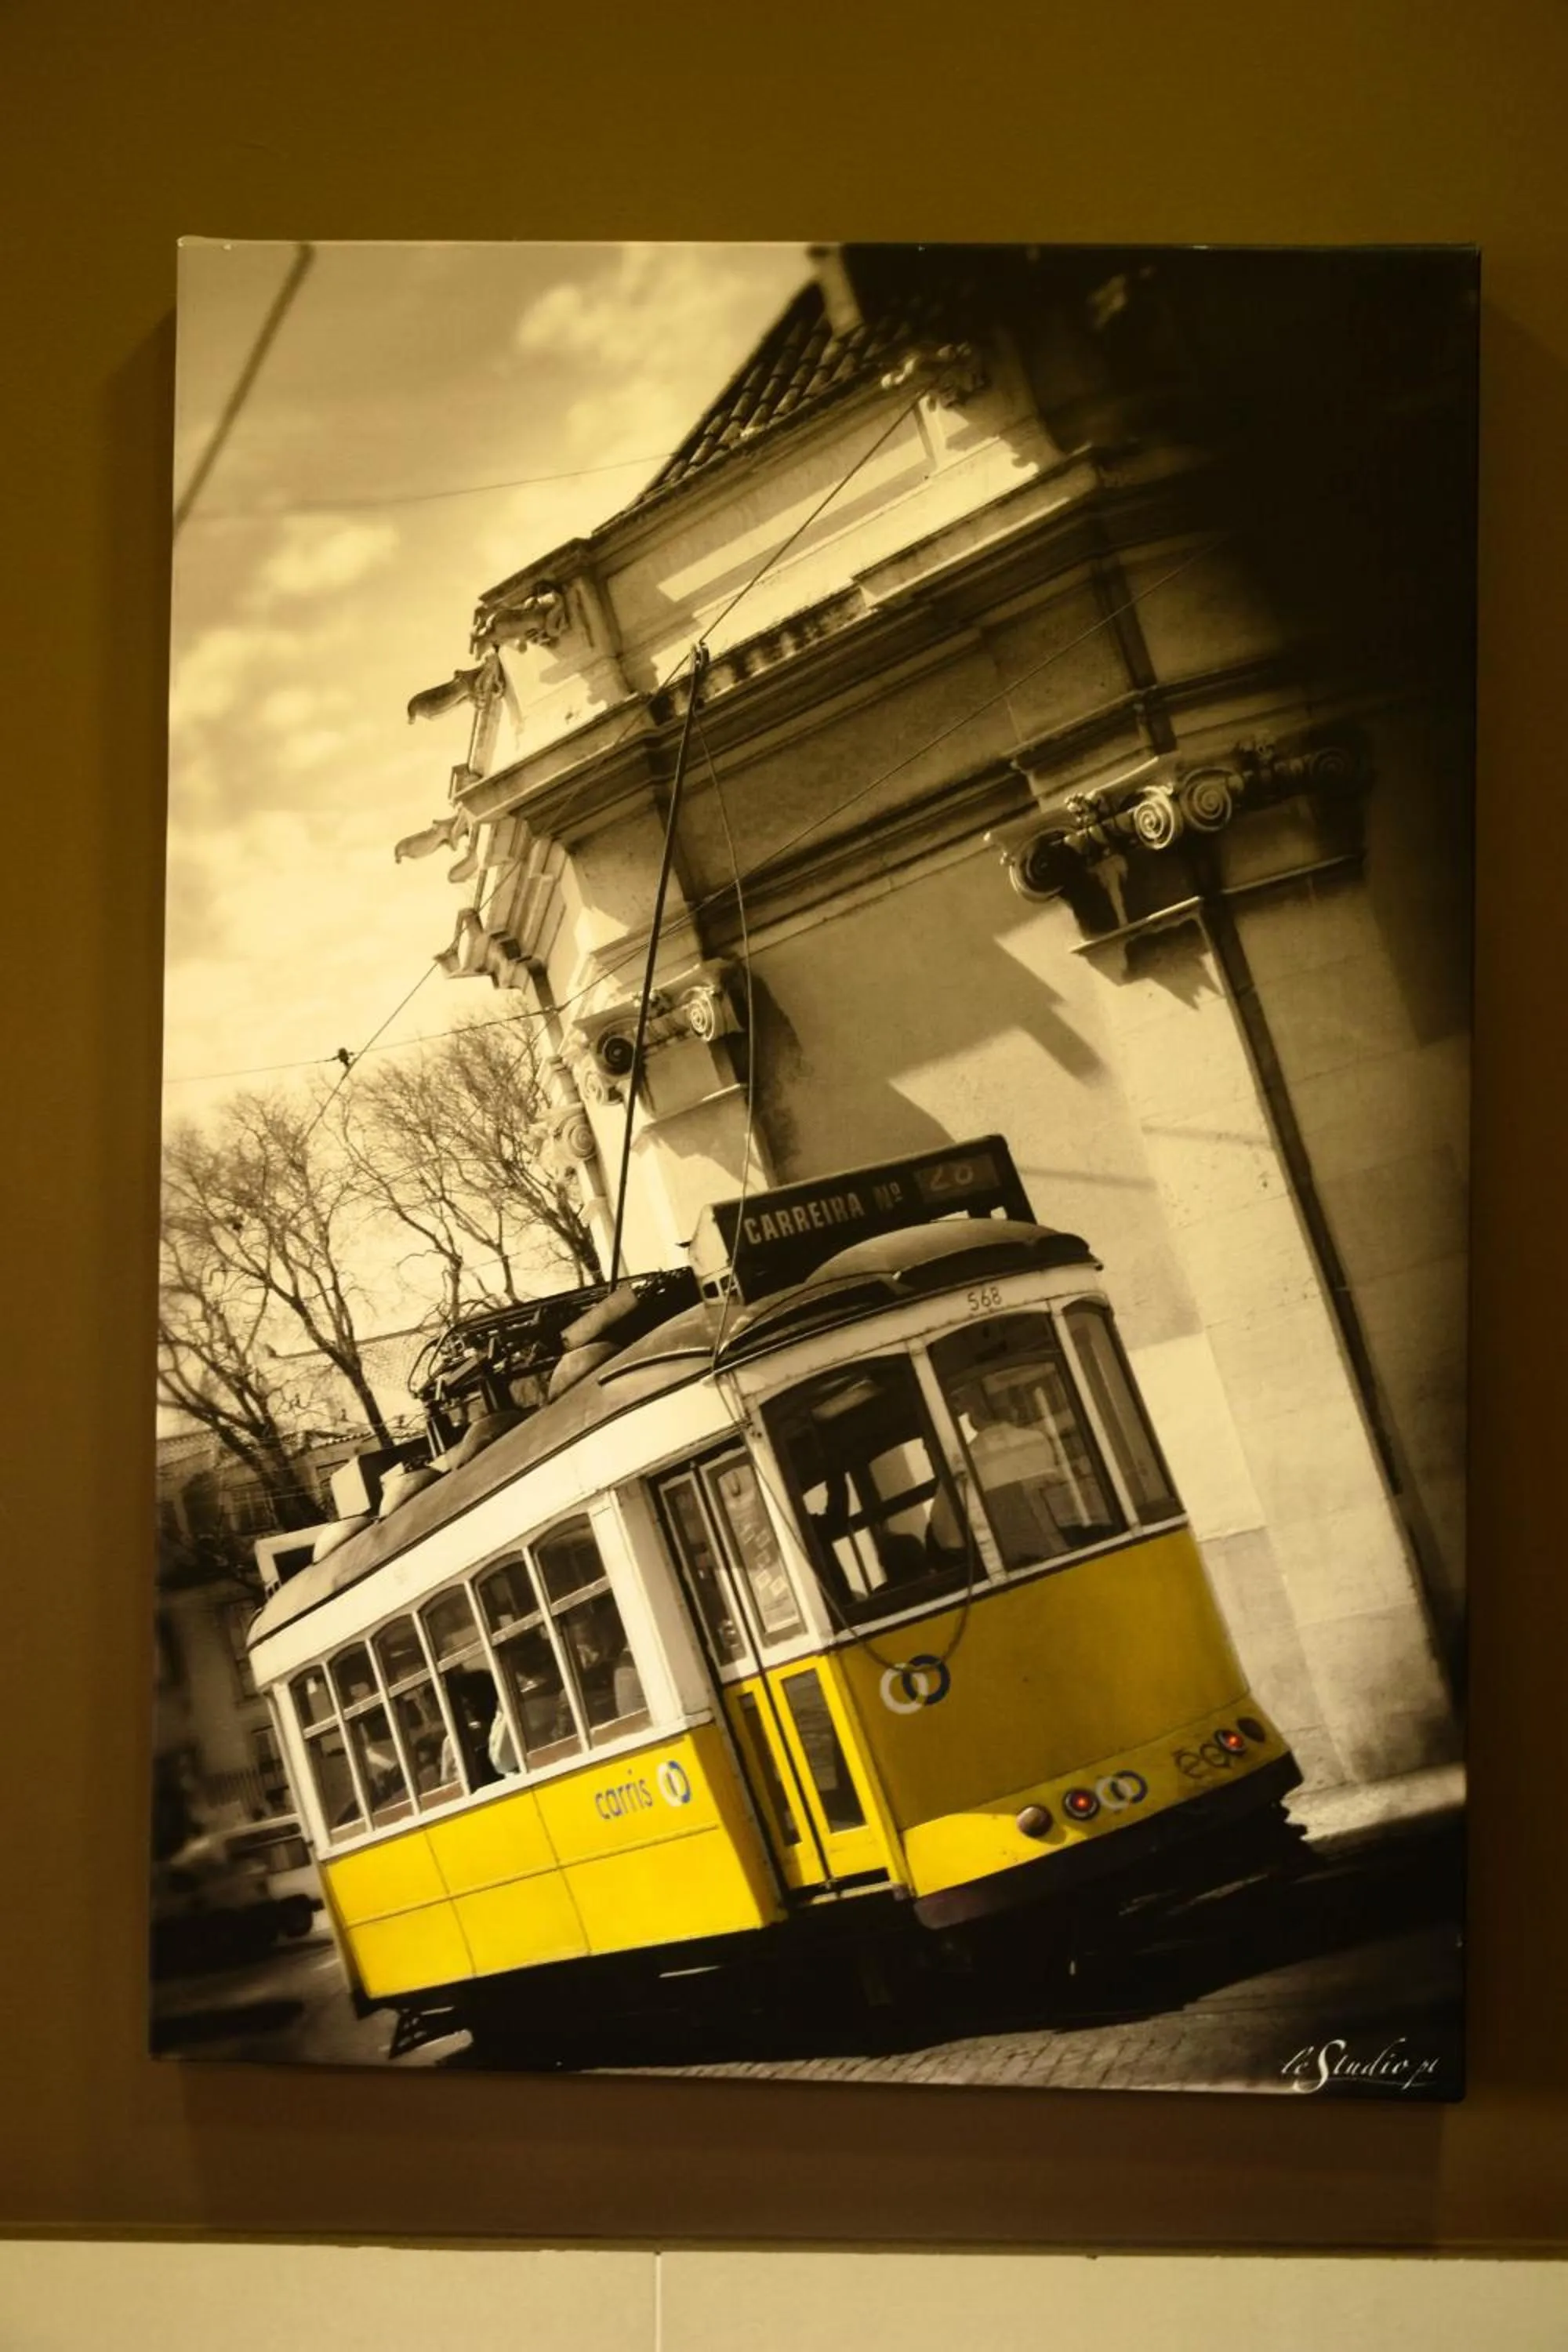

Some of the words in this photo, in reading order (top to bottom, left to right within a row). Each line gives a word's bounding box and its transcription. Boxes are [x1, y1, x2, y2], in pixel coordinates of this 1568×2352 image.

[744, 1192, 865, 1244] CARREIRA
[967, 1287, 1001, 1311] 568
[594, 1768, 653, 1820] carris
